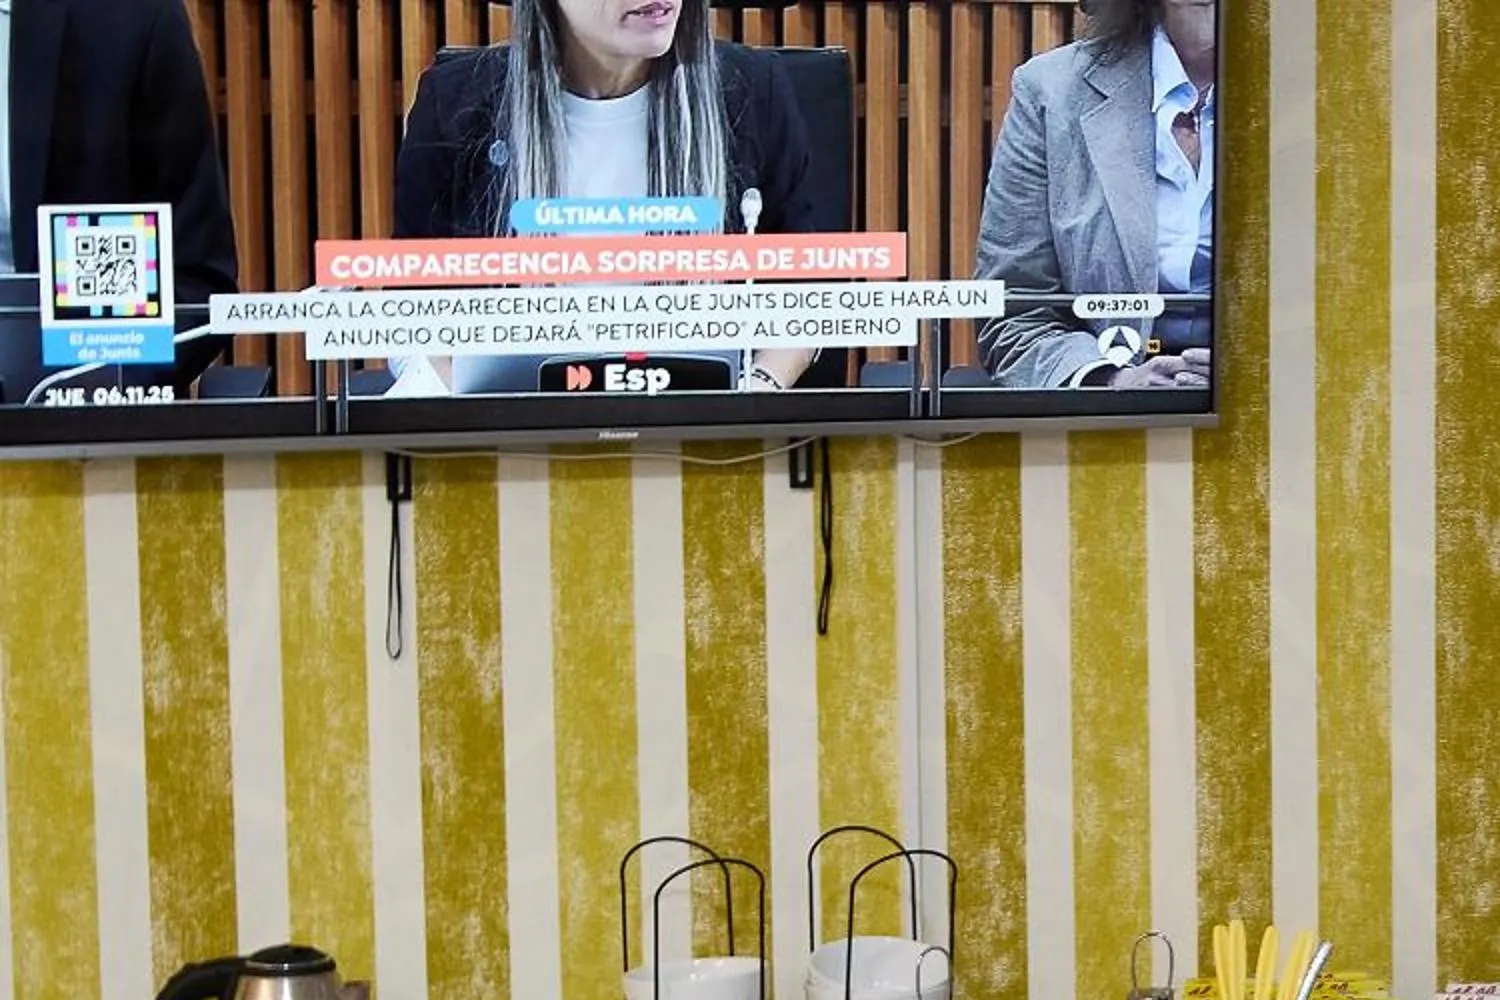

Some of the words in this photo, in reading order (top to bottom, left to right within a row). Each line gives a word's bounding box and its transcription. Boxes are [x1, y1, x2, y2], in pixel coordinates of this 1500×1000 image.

[535, 203, 625, 225] ÚLTIMA
[628, 205, 697, 223] HORA
[330, 252, 592, 278] COMPARECENCIA
[598, 248, 750, 273] SORPRESA
[757, 249, 795, 271] DE
[801, 247, 890, 270] JUNTS
[226, 301, 342, 321] ARRANCA
[349, 302, 375, 319] LA
[381, 296, 581, 317] COMPARECENCIA
[587, 295, 616, 313] EN
[622, 294, 649, 312] LA
[655, 293, 702, 315] QUE
[708, 292, 778, 311] JUNTS
[783, 291, 833, 310] DICE
[839, 290, 884, 311] QUE
[891, 285, 951, 308] HARÁ
[957, 289, 988, 306] UN
[1086, 299, 1150, 312] 09:37:01
[69, 332, 84, 345] El
[86, 330, 144, 344] anuncio
[323, 327, 432, 347] ANUNCIO
[438, 325, 486, 348] QUE
[492, 319, 582, 344] DEJARÁ
[587, 321, 748, 342] "PETRIFICADO"
[753, 319, 780, 338] AL
[786, 317, 902, 337] GOBIERNO
[77, 349, 97, 360] de
[100, 347, 141, 360] Junts
[605, 364, 671, 396] Esp
[44, 387, 86, 406] JUE
[93, 385, 175, 405] 06.11.25
